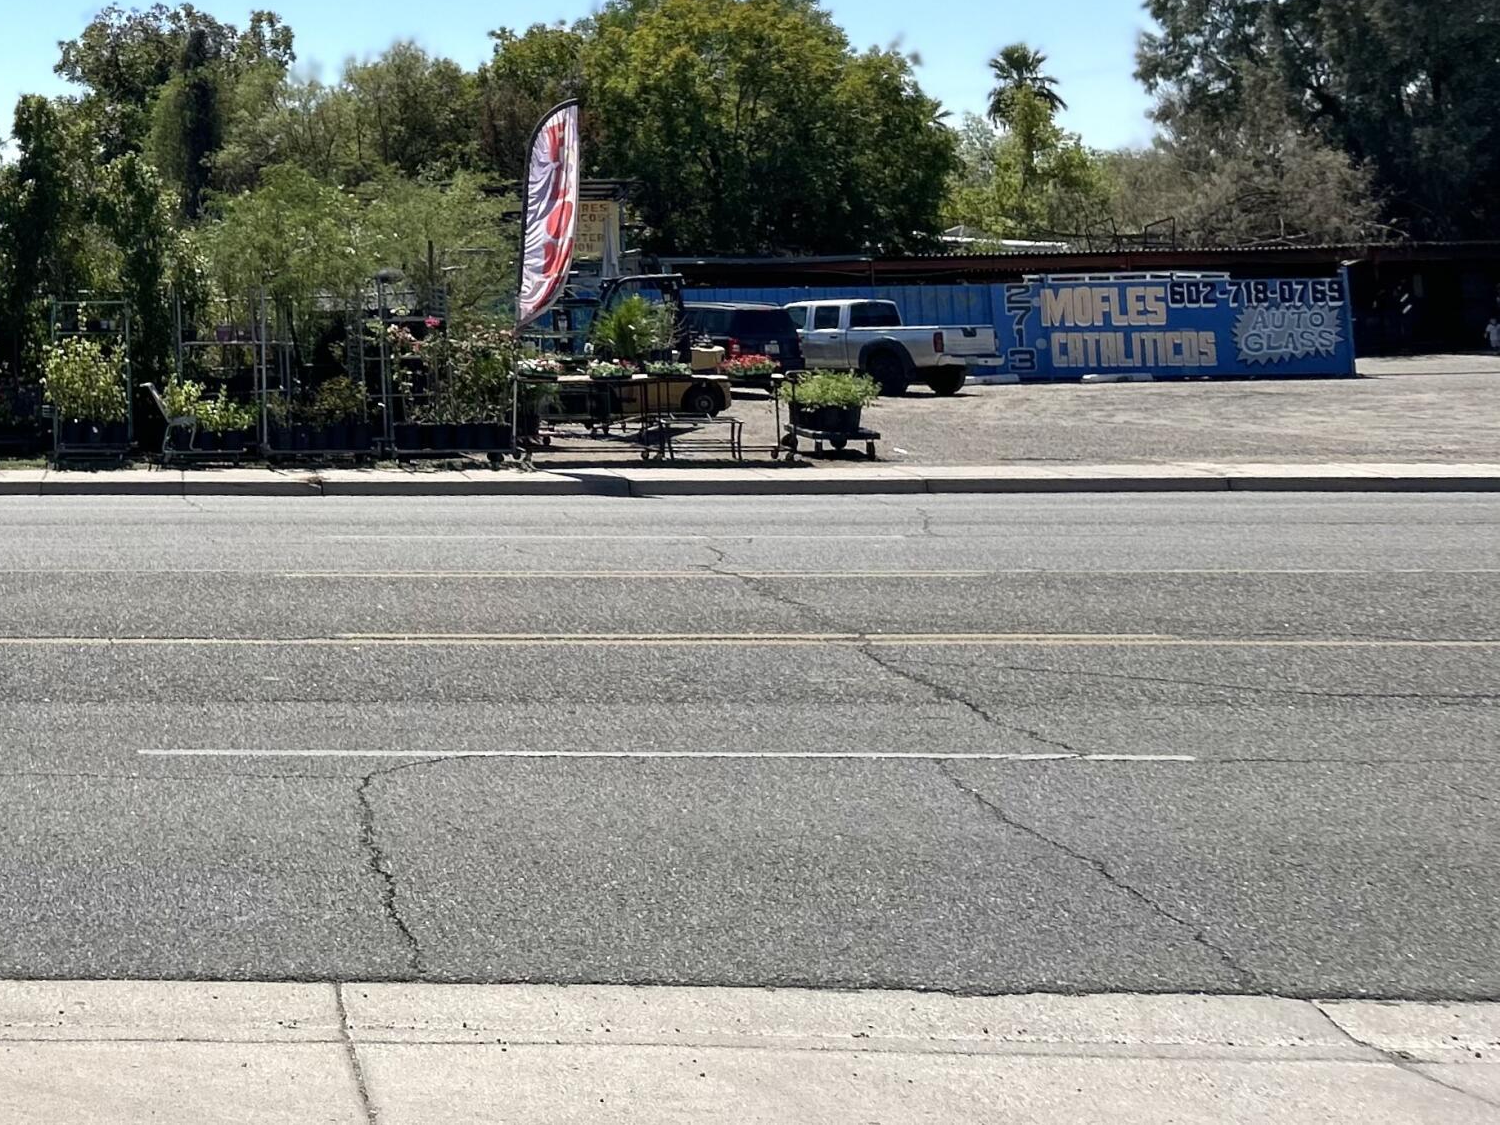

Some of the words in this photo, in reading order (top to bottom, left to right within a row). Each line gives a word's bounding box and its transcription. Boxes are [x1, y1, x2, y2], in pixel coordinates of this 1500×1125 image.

[1039, 286, 1167, 326] MOFLES
[1168, 281, 1344, 307] 602-718-0769
[1251, 308, 1326, 330] AUTO
[1051, 331, 1218, 367] CATALITICOS
[1243, 330, 1335, 355] GLASS
